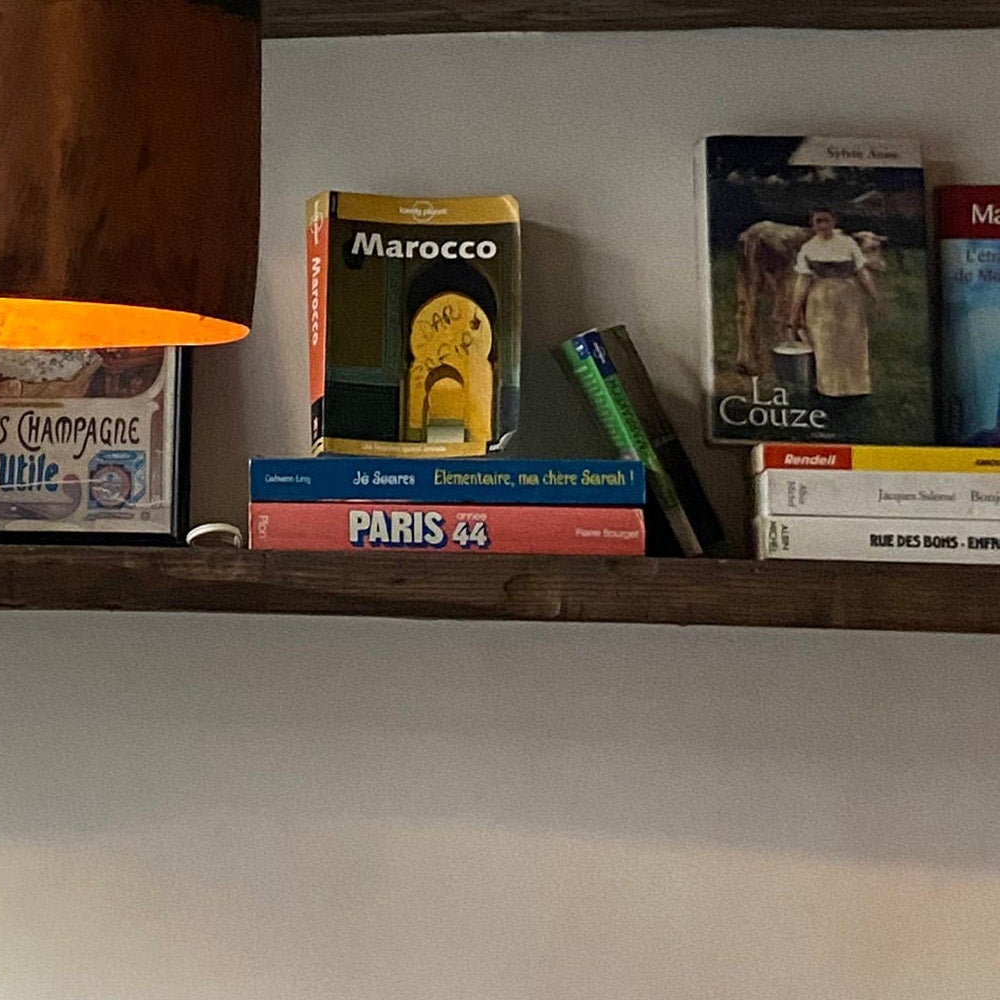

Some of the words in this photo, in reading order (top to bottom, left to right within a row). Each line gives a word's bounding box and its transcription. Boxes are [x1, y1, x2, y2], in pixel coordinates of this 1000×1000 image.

[350, 231, 498, 260] Marocco
[310, 256, 321, 347] Marocco
[752, 376, 790, 406] La
[717, 395, 829, 430] Couze
[16, 410, 142, 460] CHAMPAGNE
[783, 453, 837, 467] Rendell
[517, 473, 540, 487] ma
[542, 469, 579, 487] chère
[580, 468, 627, 487] Sarah
[877, 488, 917, 504] Jacques
[258, 514, 269, 540] Plon
[348, 509, 446, 547] PARIS
[450, 519, 491, 549] 44
[456, 511, 488, 523] année
[869, 533, 894, 548] RUE
[897, 534, 921, 549] DES
